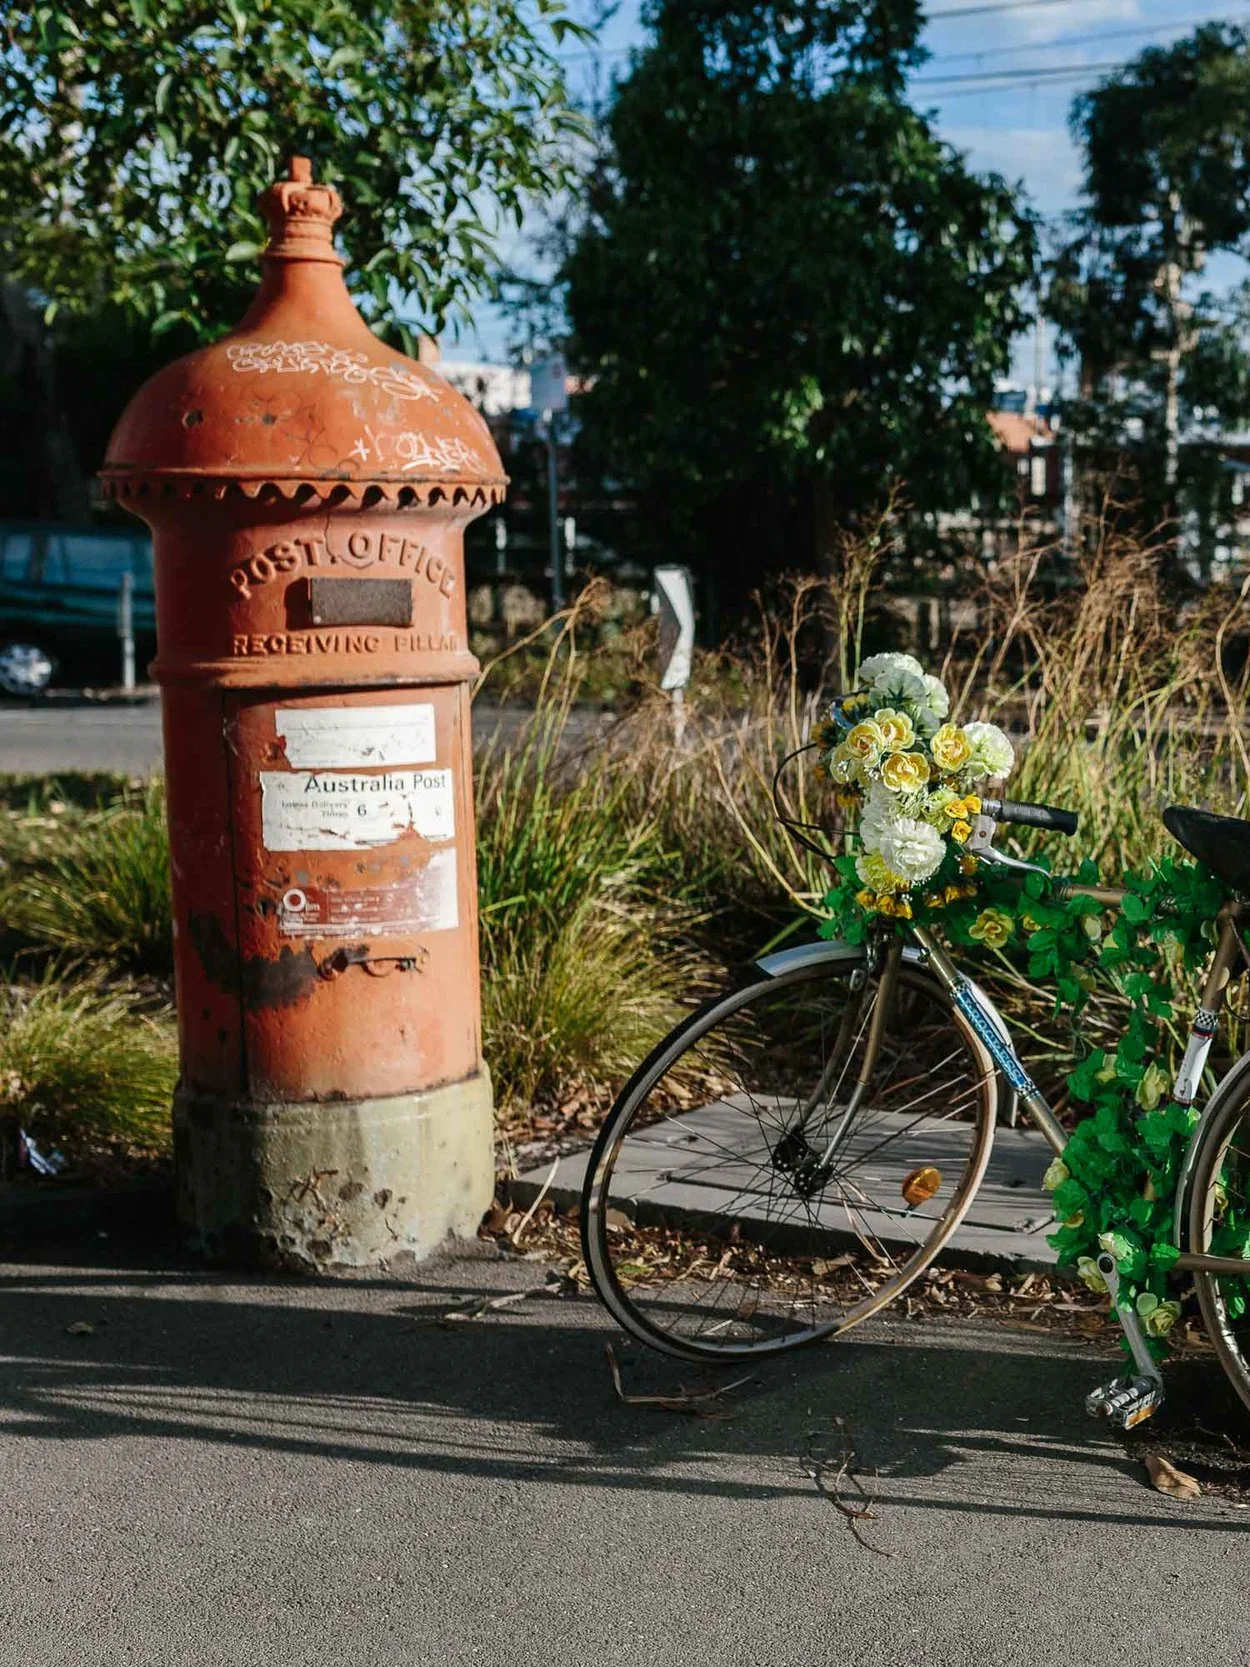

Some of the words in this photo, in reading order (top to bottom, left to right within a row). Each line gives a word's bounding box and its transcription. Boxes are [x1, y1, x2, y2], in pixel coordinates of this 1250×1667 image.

[230, 538, 325, 599] POST
[347, 531, 455, 599] OFFICE
[232, 635, 380, 655] RECEIVING
[303, 774, 405, 793] Australia
[412, 773, 447, 789] Post
[357, 803, 368, 816] 6
